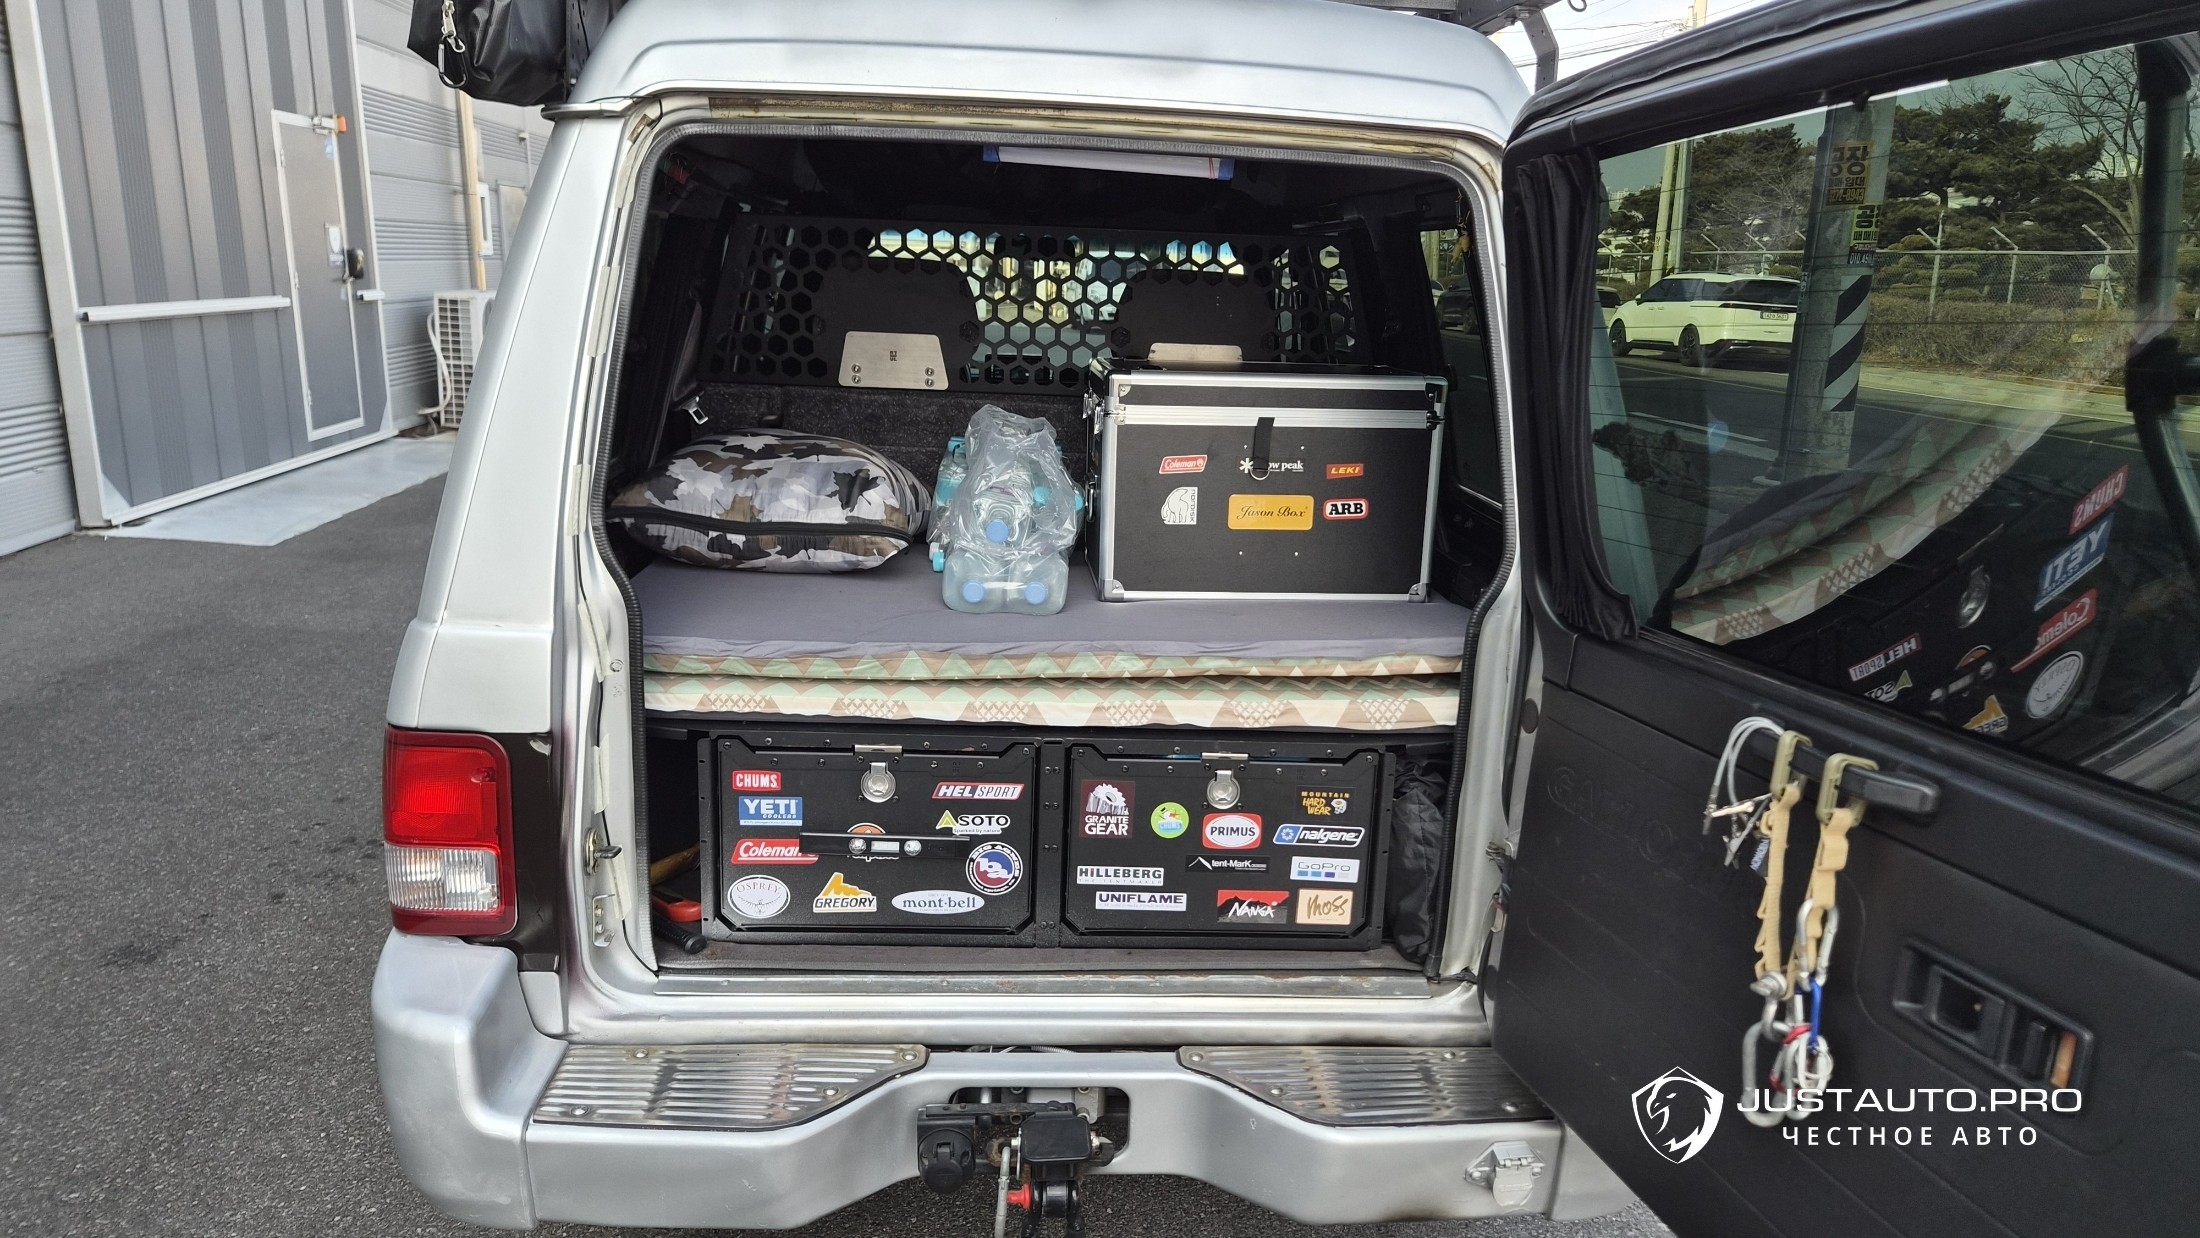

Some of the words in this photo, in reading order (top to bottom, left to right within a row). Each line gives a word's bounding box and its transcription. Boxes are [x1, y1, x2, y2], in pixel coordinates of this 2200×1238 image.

[1855, 204, 1880, 228] 공
[1164, 459, 1197, 469] Coleman
[1281, 460, 1304, 471] peak
[1330, 466, 1360, 474] LEKI
[1236, 505, 1274, 519] Jason
[1276, 505, 1306, 517] Box
[1328, 502, 1364, 515] ARB
[736, 773, 779, 788] CHUMS
[938, 785, 973, 797] HEL
[977, 786, 1017, 798] SPORT
[743, 798, 797, 815] YETI
[1302, 797, 1326, 807] HARD
[1307, 806, 1332, 816] WEAR
[958, 815, 1008, 826] SOTO
[1084, 814, 1130, 824] GRANITE
[1084, 823, 1128, 836] GEAR
[1210, 826, 1256, 837] PRIMUS
[1299, 828, 1359, 844] nalgene
[1298, 862, 1351, 872] GoPro
[736, 881, 780, 894] OSPREY
[814, 897, 875, 909] GREGORY
[1099, 893, 1184, 904] UNIFLAME
[1228, 898, 1276, 918] NANGA
